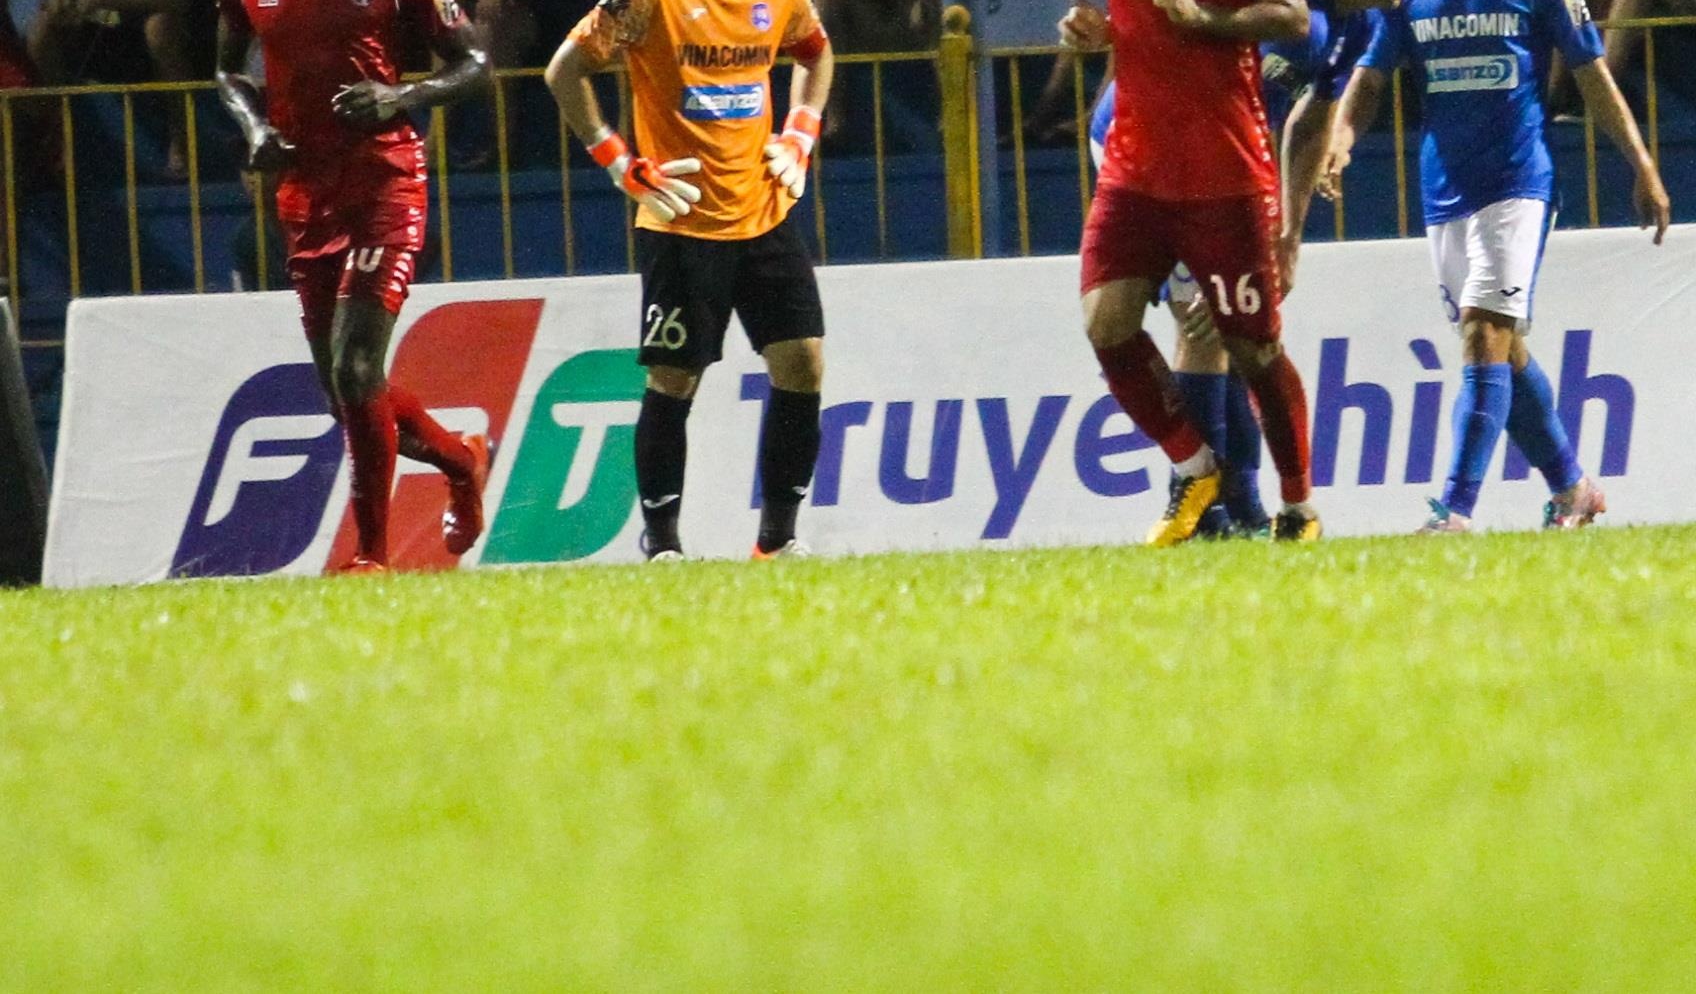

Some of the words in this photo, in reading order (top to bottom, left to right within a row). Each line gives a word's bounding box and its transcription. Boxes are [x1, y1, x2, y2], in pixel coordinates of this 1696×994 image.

[1410, 12, 1519, 43] VINACOMIN
[677, 43, 771, 68] VINACOMIN
[1210, 273, 1261, 316] 16
[643, 304, 688, 350] 26
[1311, 329, 1636, 487] hìh
